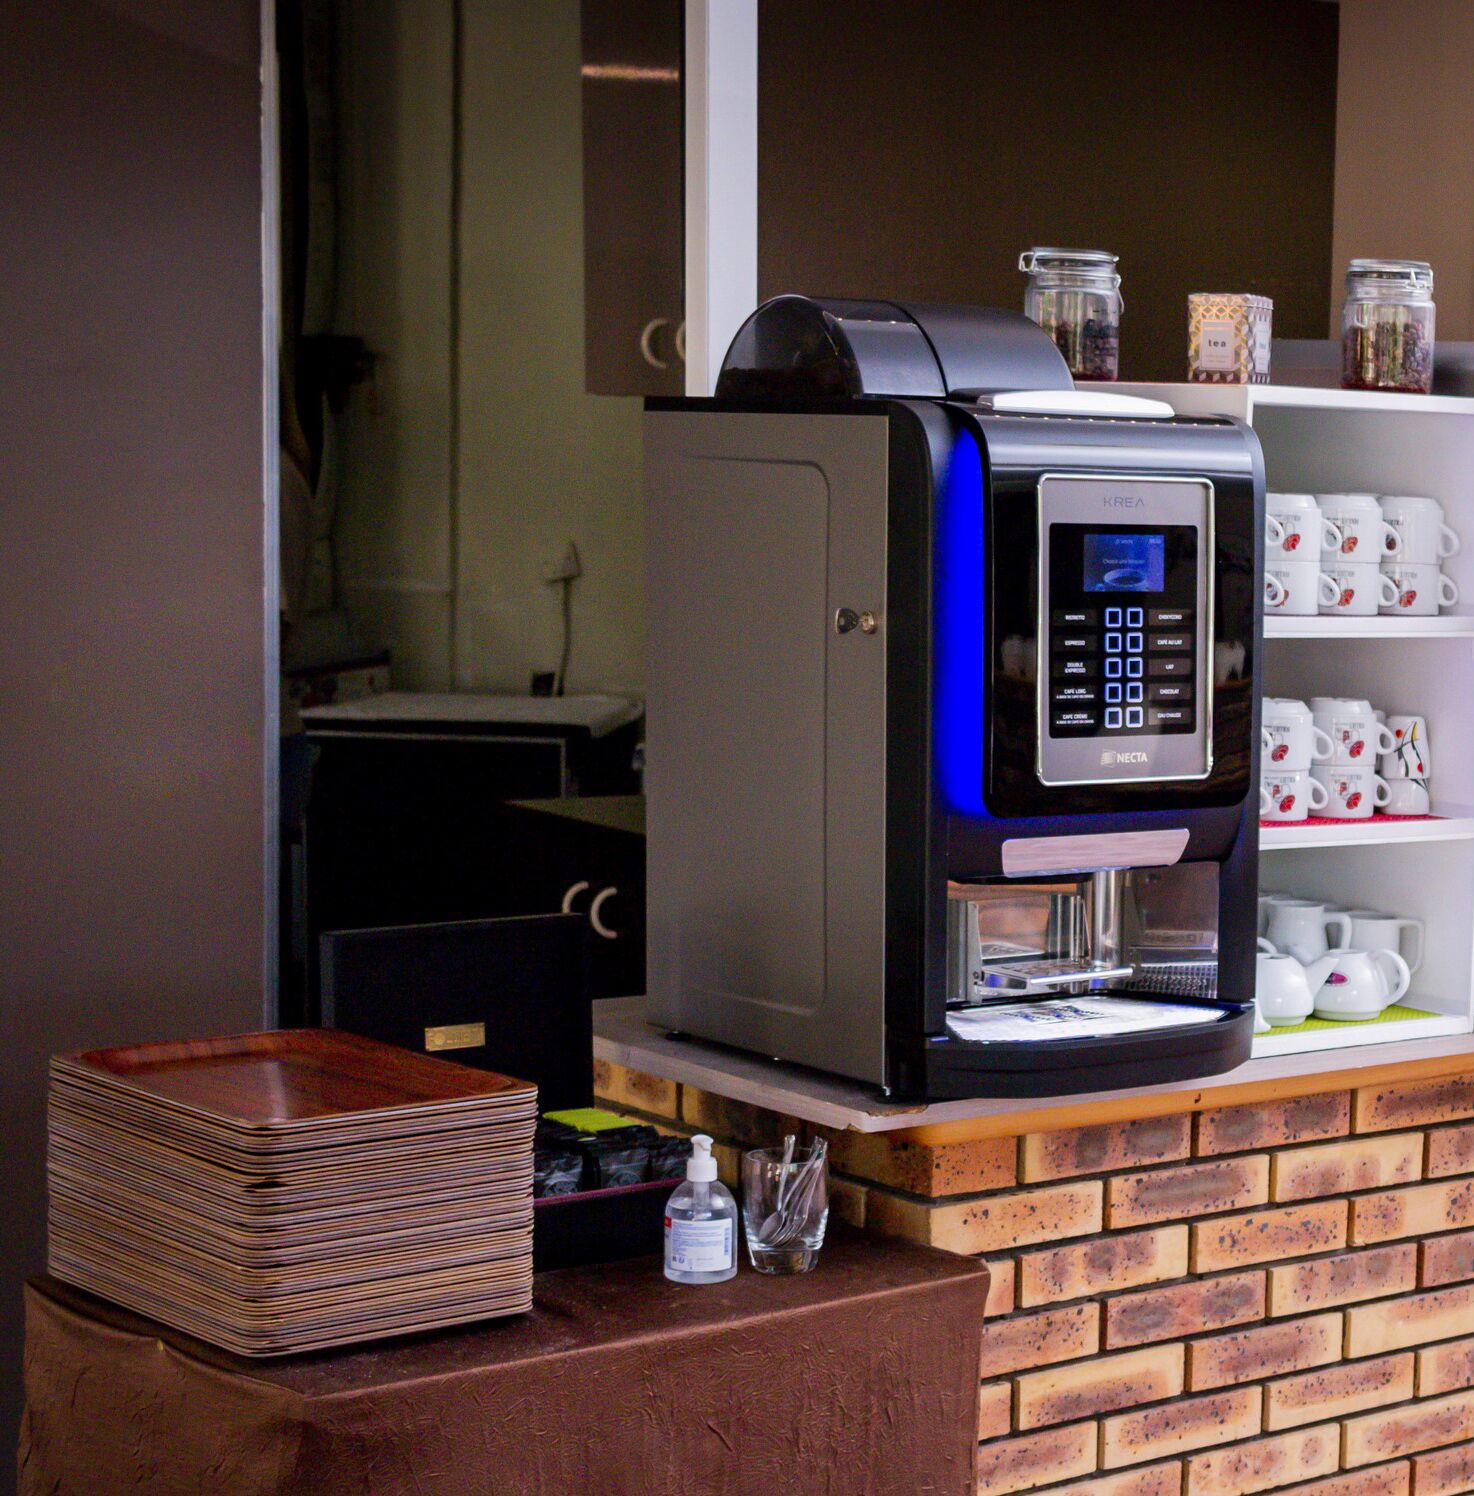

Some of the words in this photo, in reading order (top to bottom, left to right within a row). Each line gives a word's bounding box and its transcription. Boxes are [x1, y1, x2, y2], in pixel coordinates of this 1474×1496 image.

[1208, 338, 1227, 348] tea
[1103, 496, 1145, 508] KREA
[1116, 751, 1148, 763] NECTA
